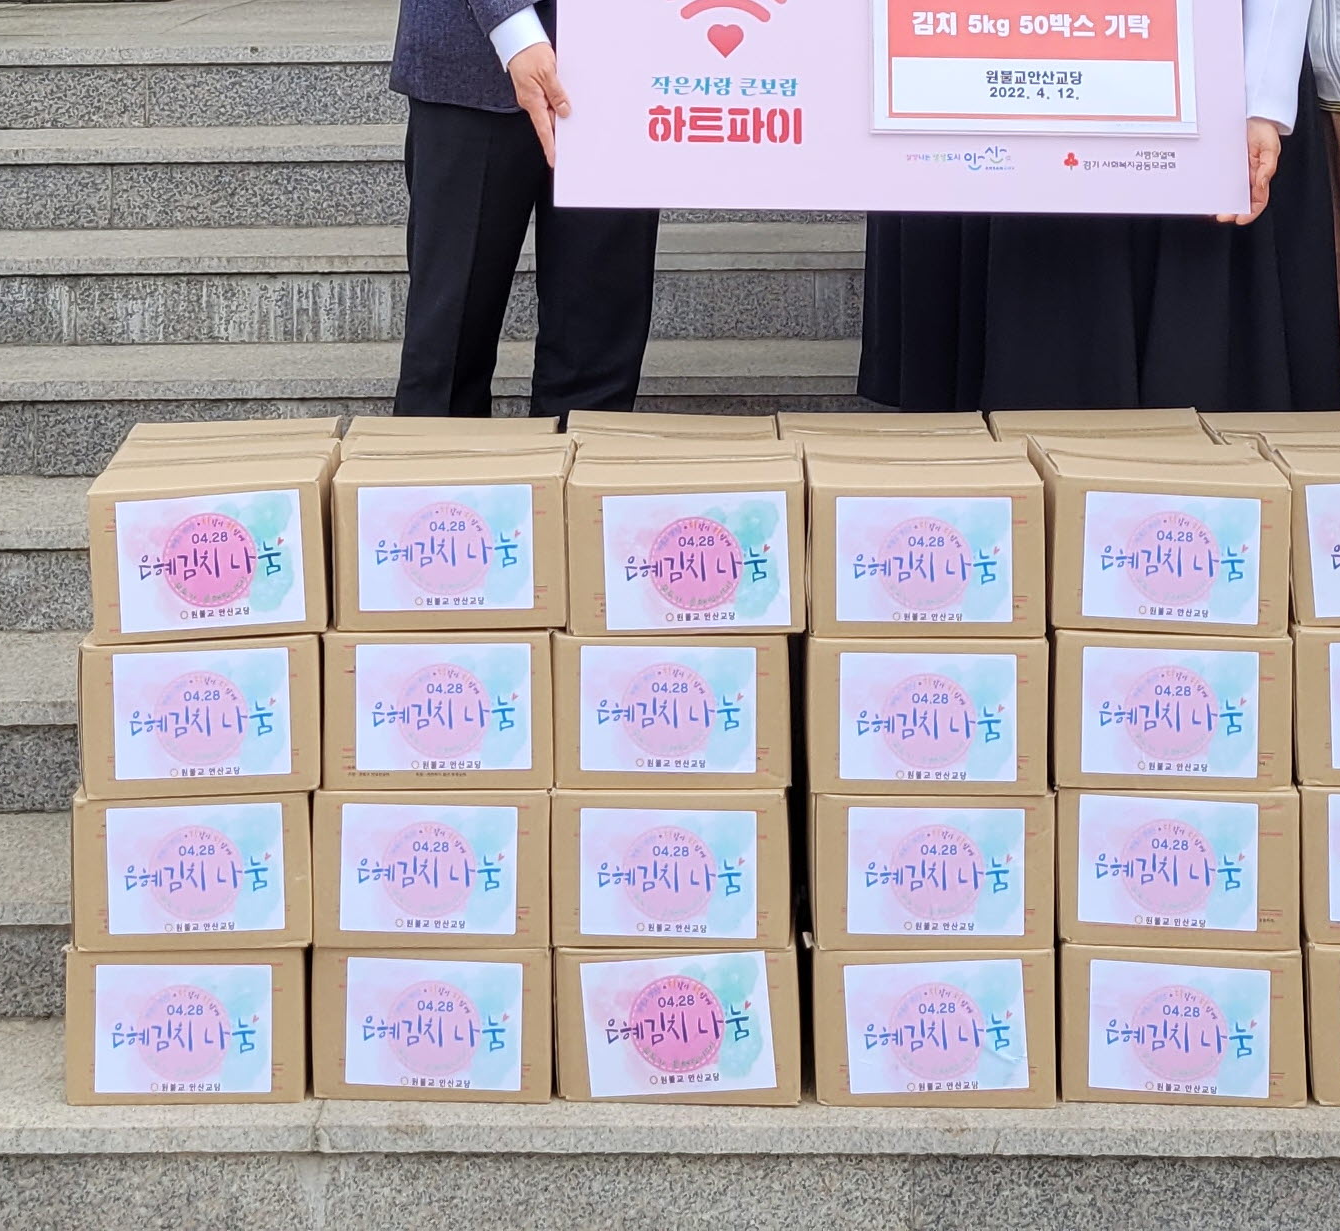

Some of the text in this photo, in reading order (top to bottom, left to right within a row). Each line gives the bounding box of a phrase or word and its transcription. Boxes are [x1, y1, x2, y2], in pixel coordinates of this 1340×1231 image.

[912, 11, 1150, 39] 김치 5kg 50박스 기탁
[985, 70, 1083, 85] 원불교안산교당
[651, 76, 798, 97] 작은사랑 큰보람
[989, 86, 1080, 100] 2022. 4. 12.
[648, 105, 802, 144] 하트파이
[429, 520, 466, 532] 04.28
[191, 530, 228, 545] 04.28
[677, 535, 715, 548] 04.28
[907, 535, 945, 547] 04.28
[1156, 529, 1193, 543] 04.28
[426, 682, 463, 694] 04.28
[651, 681, 689, 693] 04.28
[1154, 684, 1192, 697] 04.28
[183, 689, 221, 702] 04.28
[911, 692, 949, 704] 04.28
[178, 844, 216, 857] 04.28
[412, 840, 449, 853] 04.28
[920, 843, 957, 856] 04.28
[1151, 837, 1189, 851] 04.28
[652, 845, 689, 857] 04.28
[417, 999, 454, 1012] 04.28
[657, 994, 695, 1008] 04.28
[166, 1004, 204, 1016] 04.28
[918, 1001, 956, 1015] 04.28
[1162, 1004, 1201, 1018] 04.28
